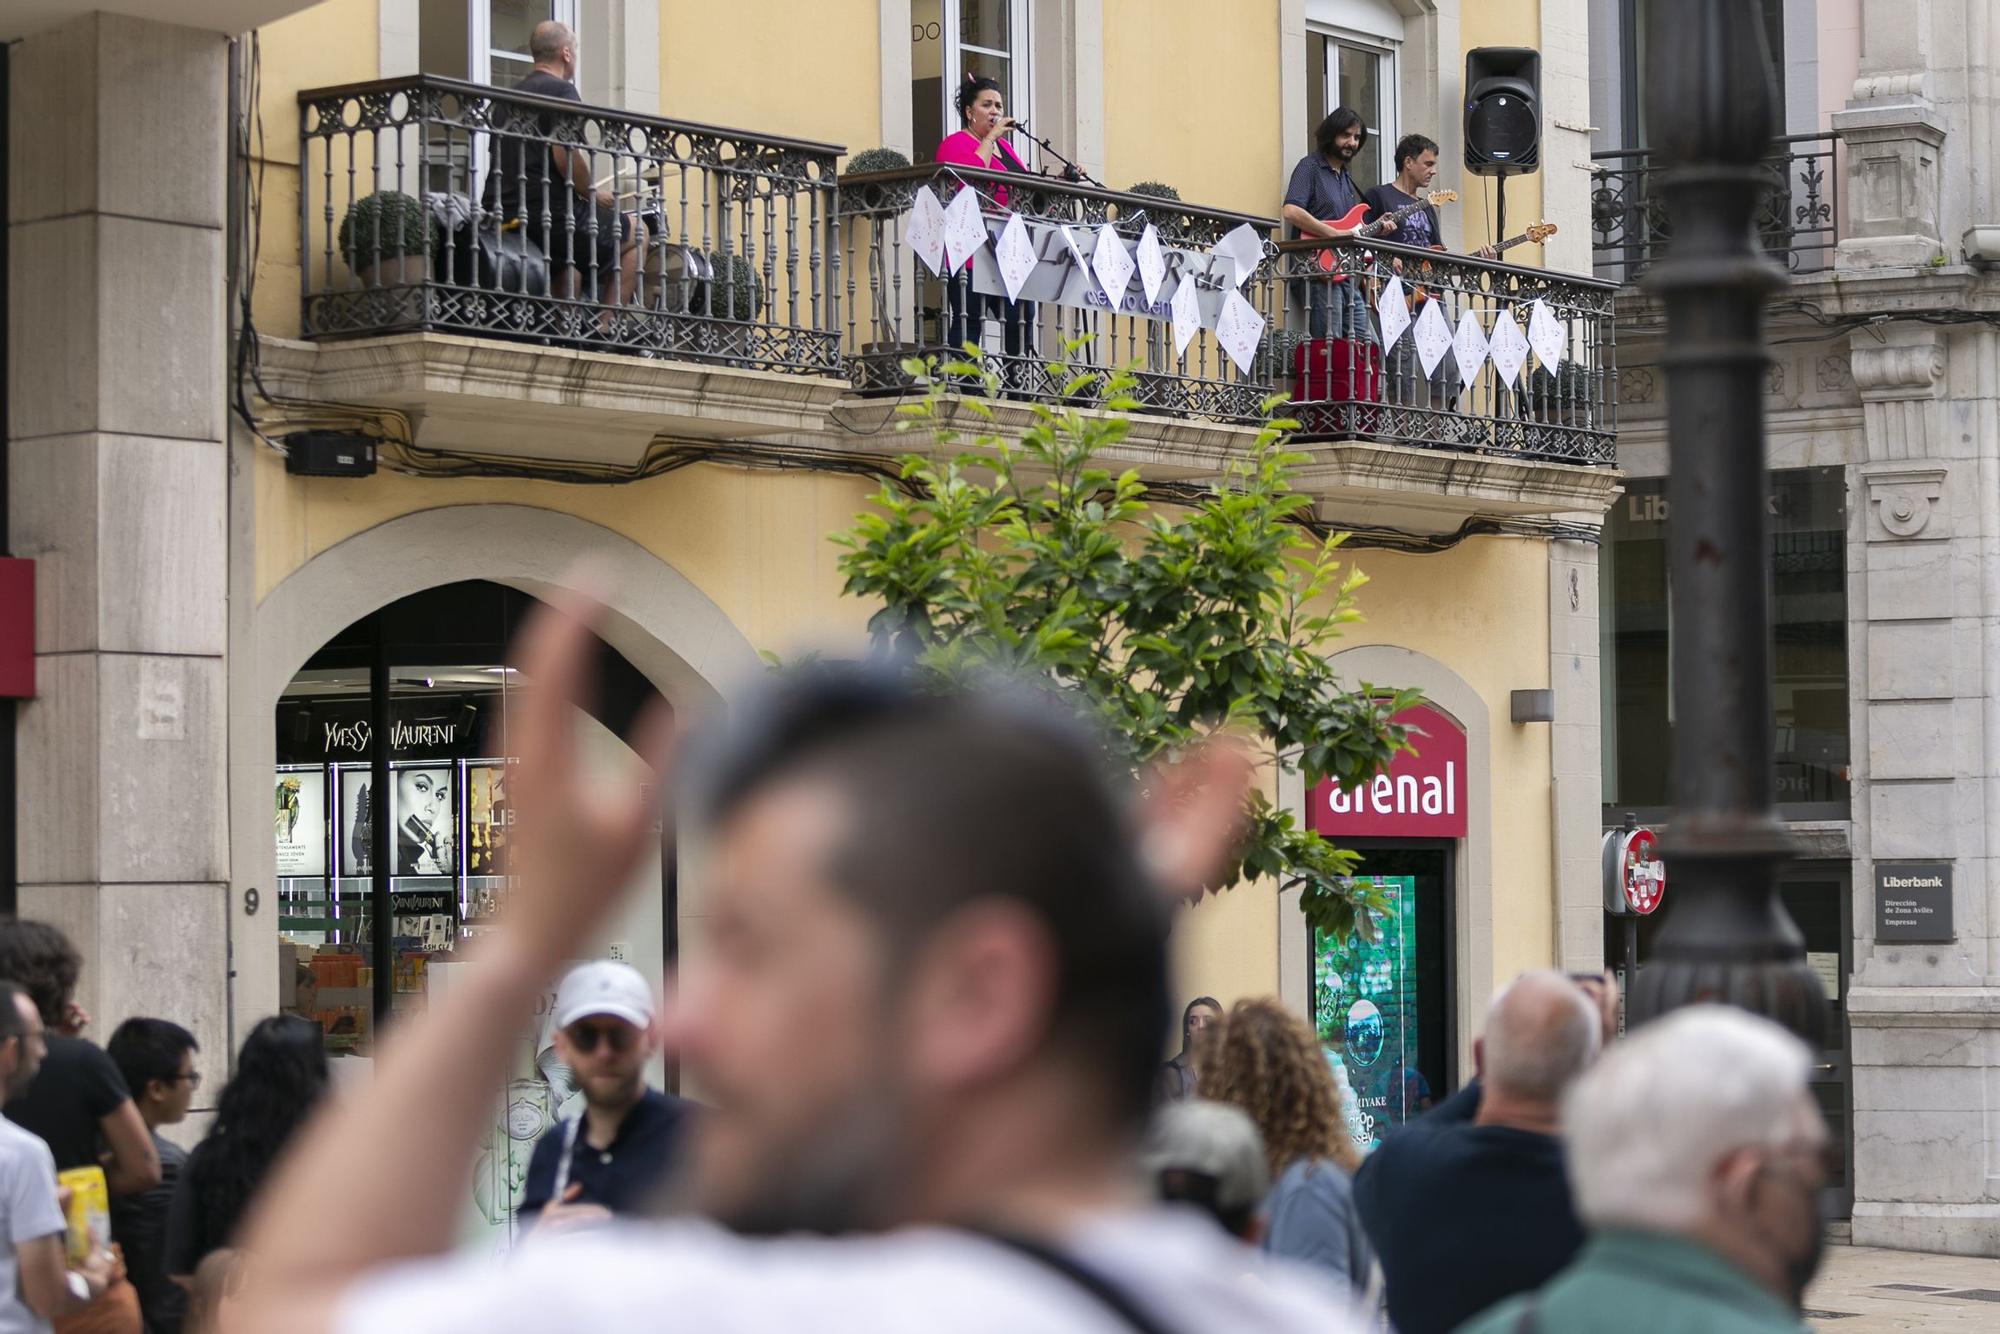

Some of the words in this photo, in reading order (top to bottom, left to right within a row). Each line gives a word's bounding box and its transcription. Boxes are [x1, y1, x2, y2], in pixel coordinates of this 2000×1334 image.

[1328, 761, 1455, 815] arenal
[1883, 876, 1943, 888] Liberbank
[244, 887, 260, 916] 9
[1885, 899, 1917, 907] Dirección
